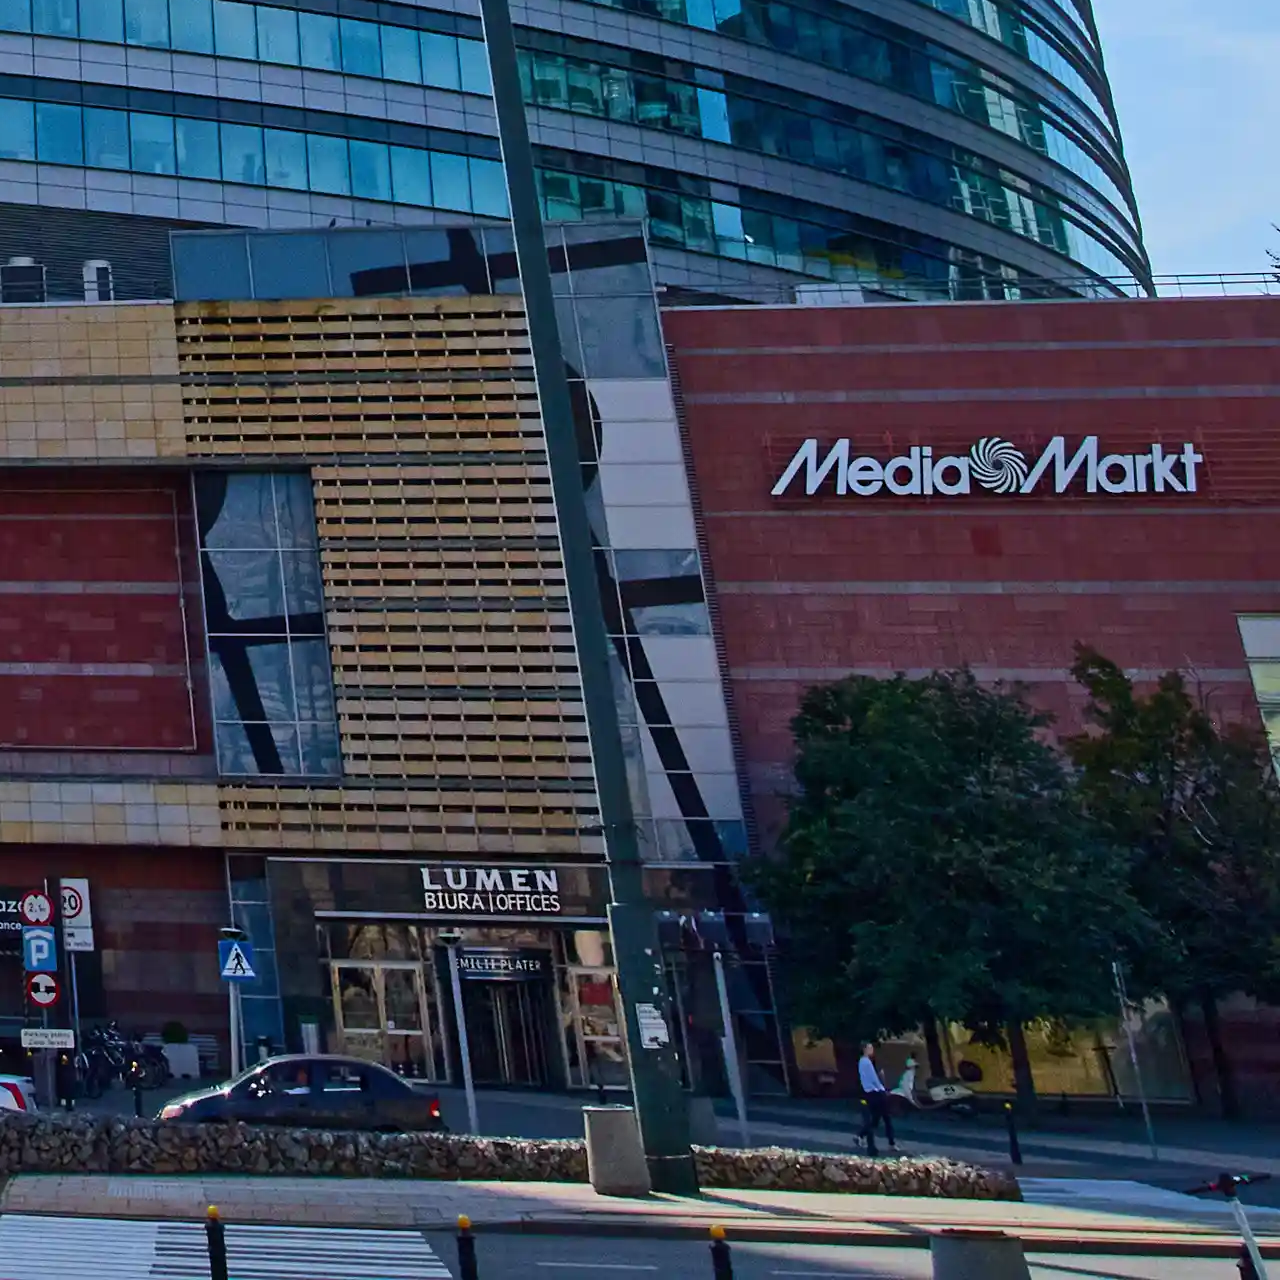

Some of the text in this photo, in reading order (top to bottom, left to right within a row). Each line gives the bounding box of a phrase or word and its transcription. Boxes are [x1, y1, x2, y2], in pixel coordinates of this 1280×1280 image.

[770, 435, 1204, 496] Media Markt
[420, 867, 559, 892] LUMEN
[424, 892, 561, 912] BIURA OFFICES
